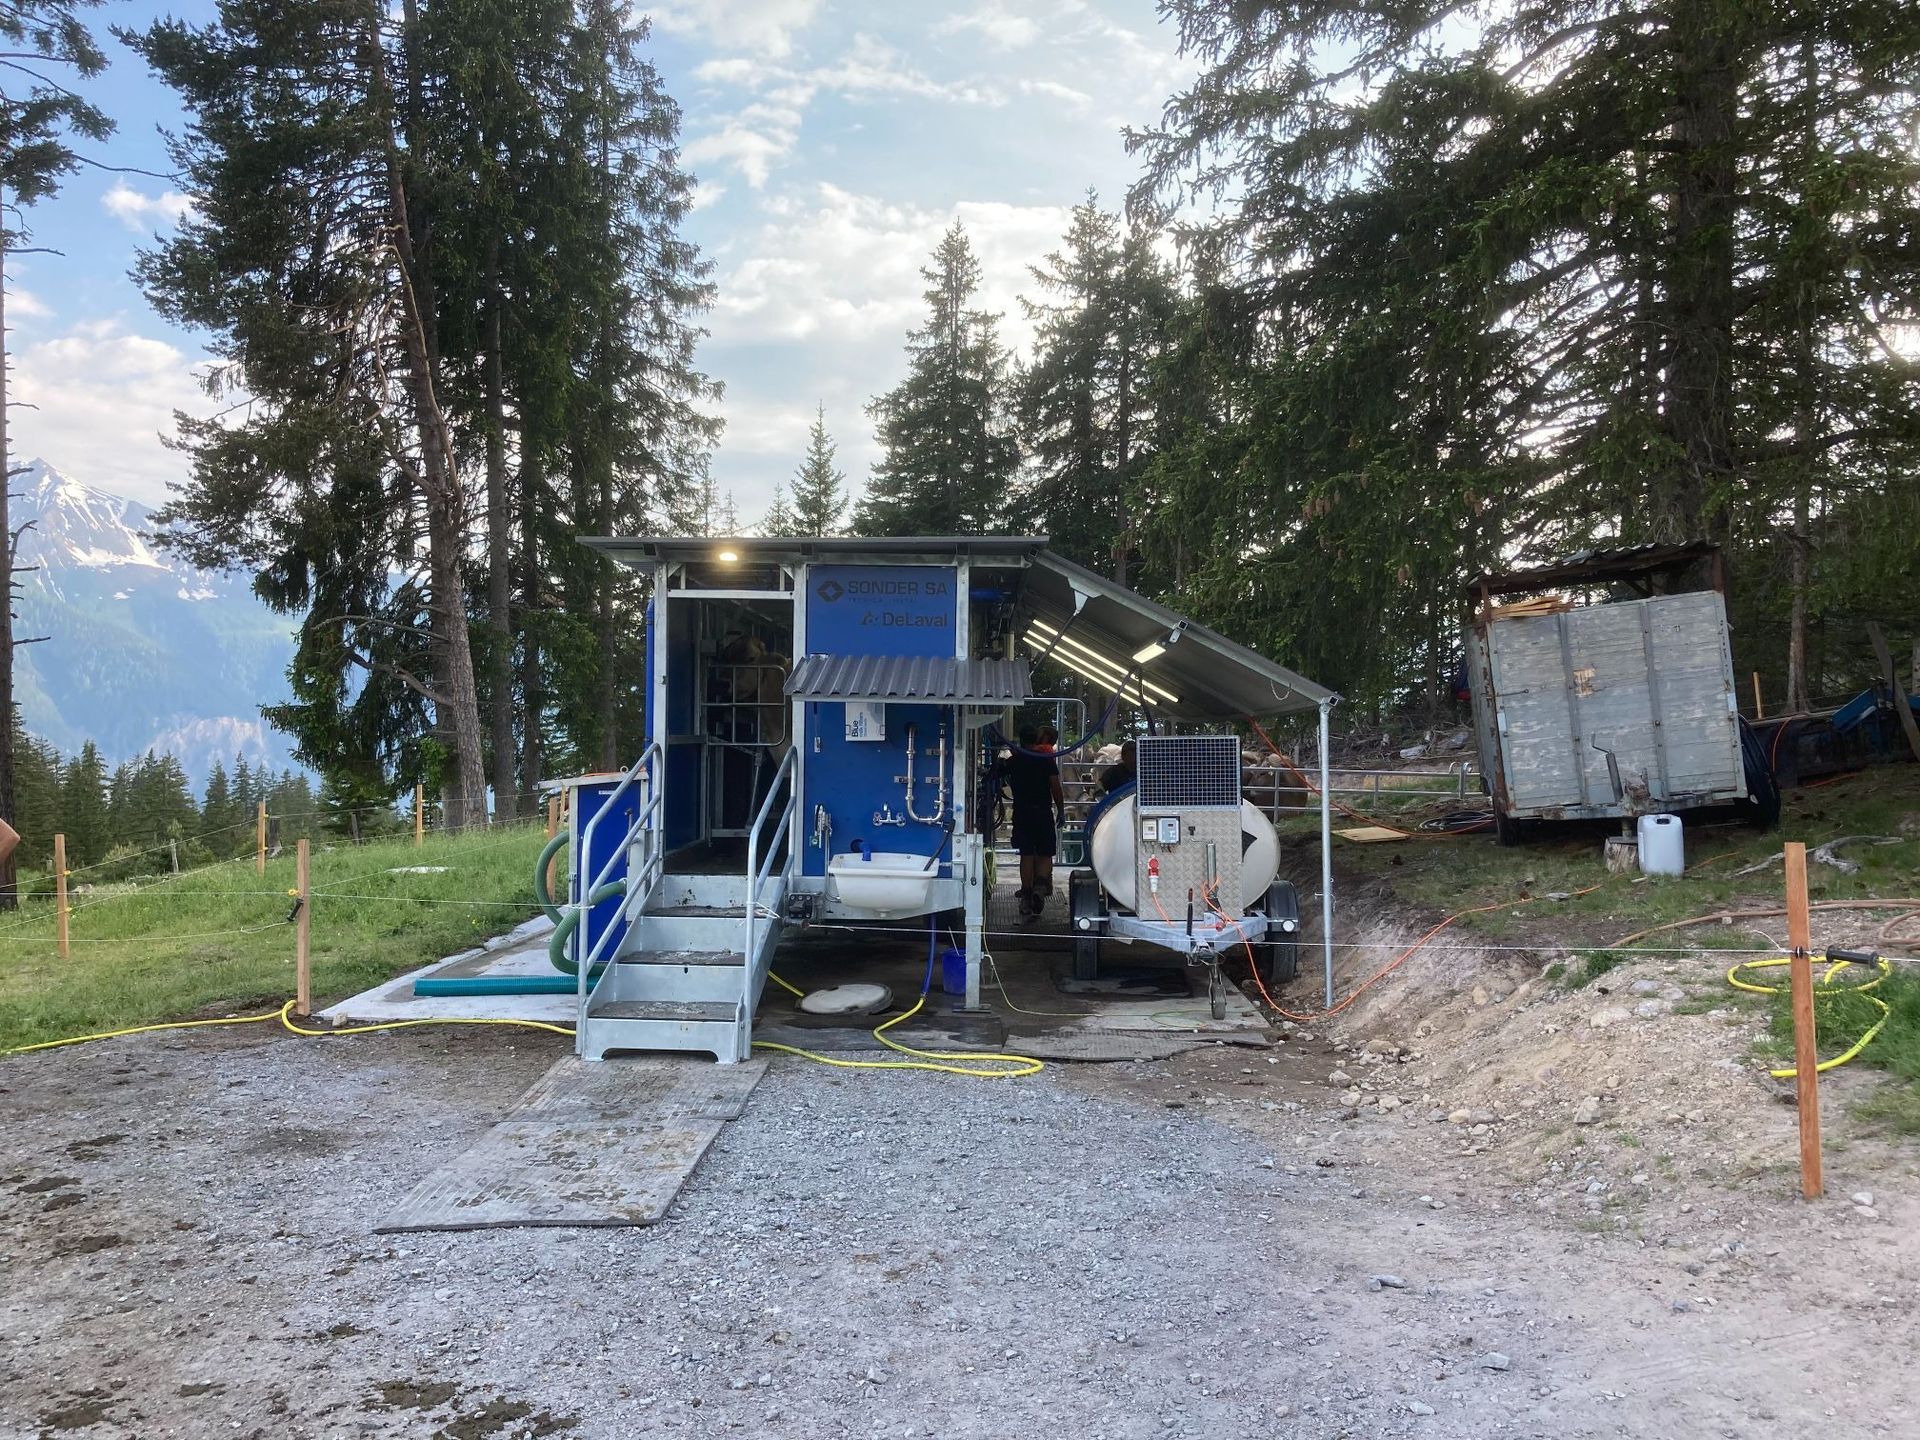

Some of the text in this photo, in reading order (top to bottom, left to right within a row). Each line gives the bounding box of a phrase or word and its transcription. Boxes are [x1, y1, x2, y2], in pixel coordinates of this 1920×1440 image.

[848, 580, 947, 596] SONDER SA
[883, 612, 947, 627] DeLaval
